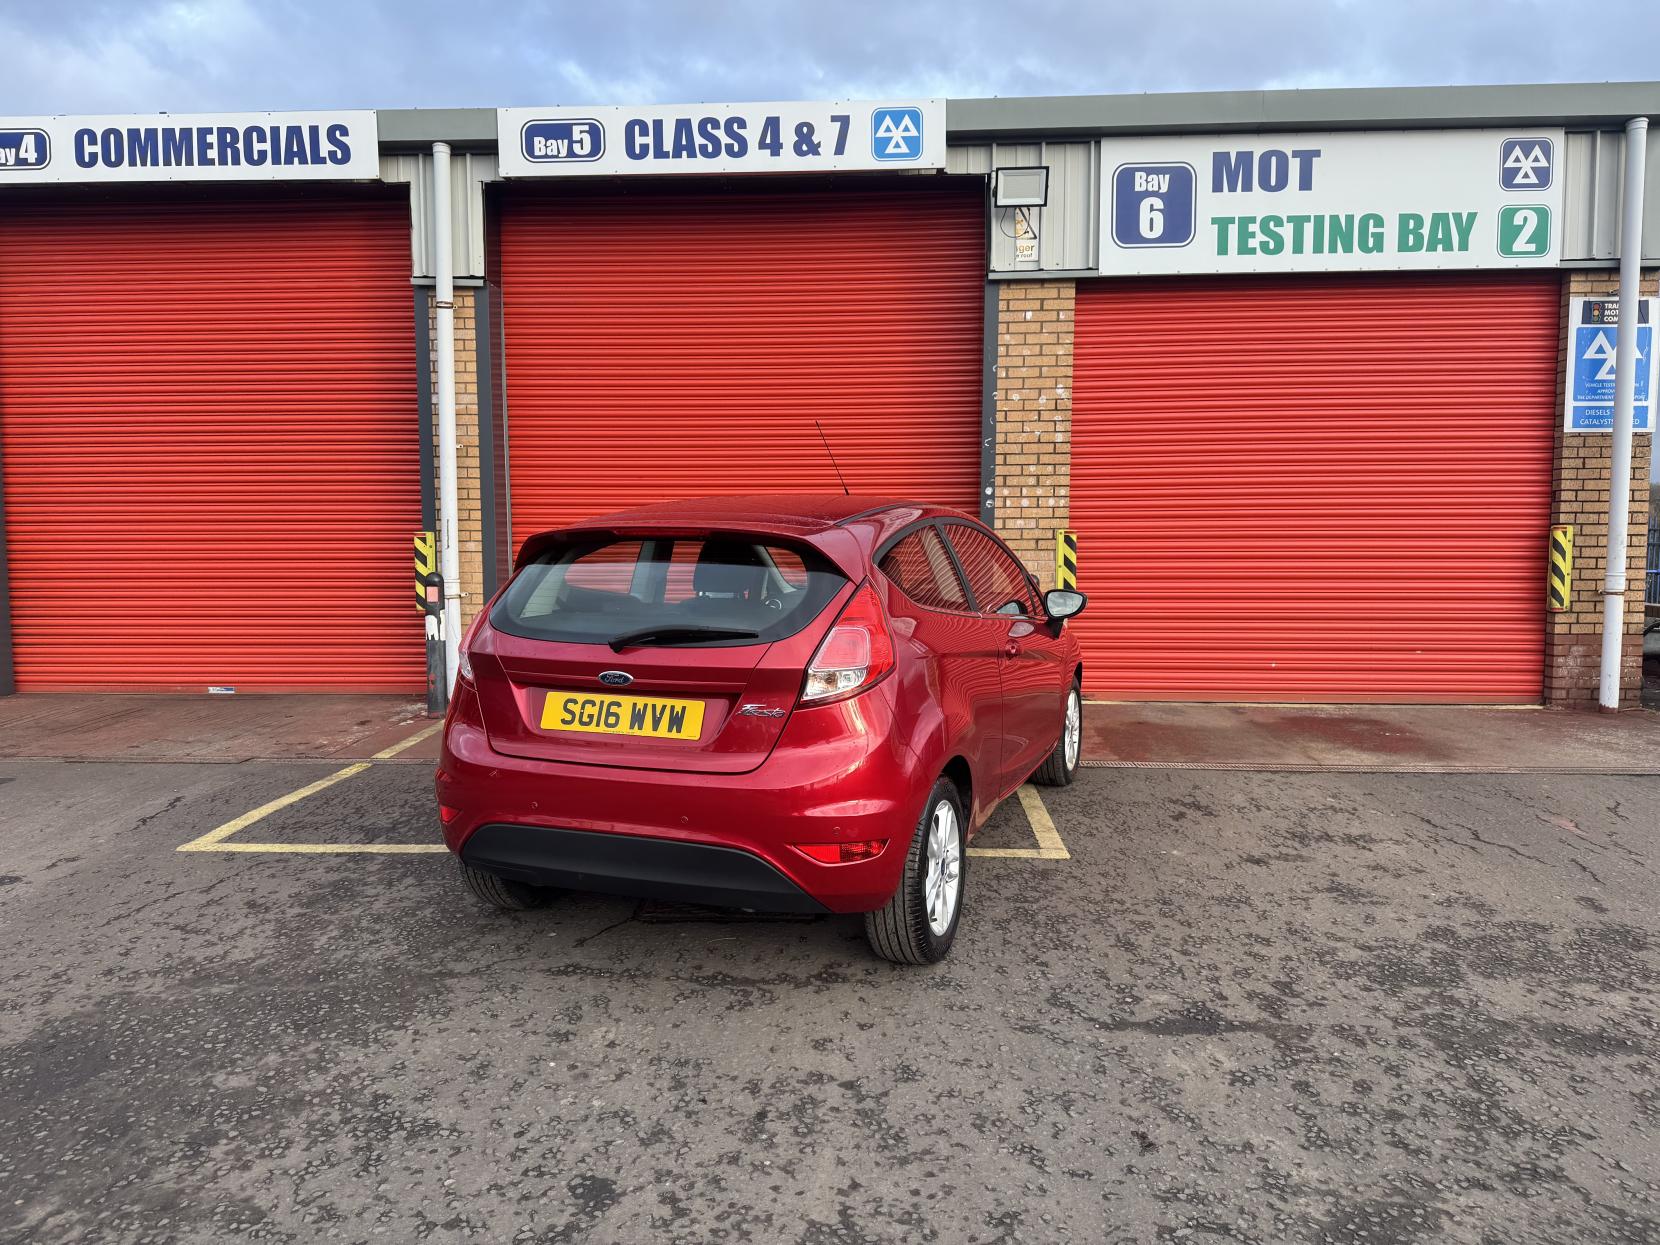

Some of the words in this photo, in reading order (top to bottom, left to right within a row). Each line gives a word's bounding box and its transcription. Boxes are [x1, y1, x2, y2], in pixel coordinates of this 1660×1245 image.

[18, 134, 38, 163] 4
[74, 123, 351, 169] COMMERCIALS
[533, 136, 568, 157] Bay
[571, 125, 592, 155] 5
[624, 117, 748, 160] CLASS
[758, 115, 783, 157] 4
[792, 121, 822, 156] &
[829, 114, 851, 155] 7
[1134, 171, 1170, 194] Bay
[1211, 149, 1322, 193] MOT
[1139, 196, 1164, 239] 6
[1211, 213, 1385, 256] TESTING
[1396, 211, 1478, 254] BAY
[1510, 208, 1537, 253] 2
[560, 697, 623, 729] SG16
[629, 701, 687, 734] WVW
